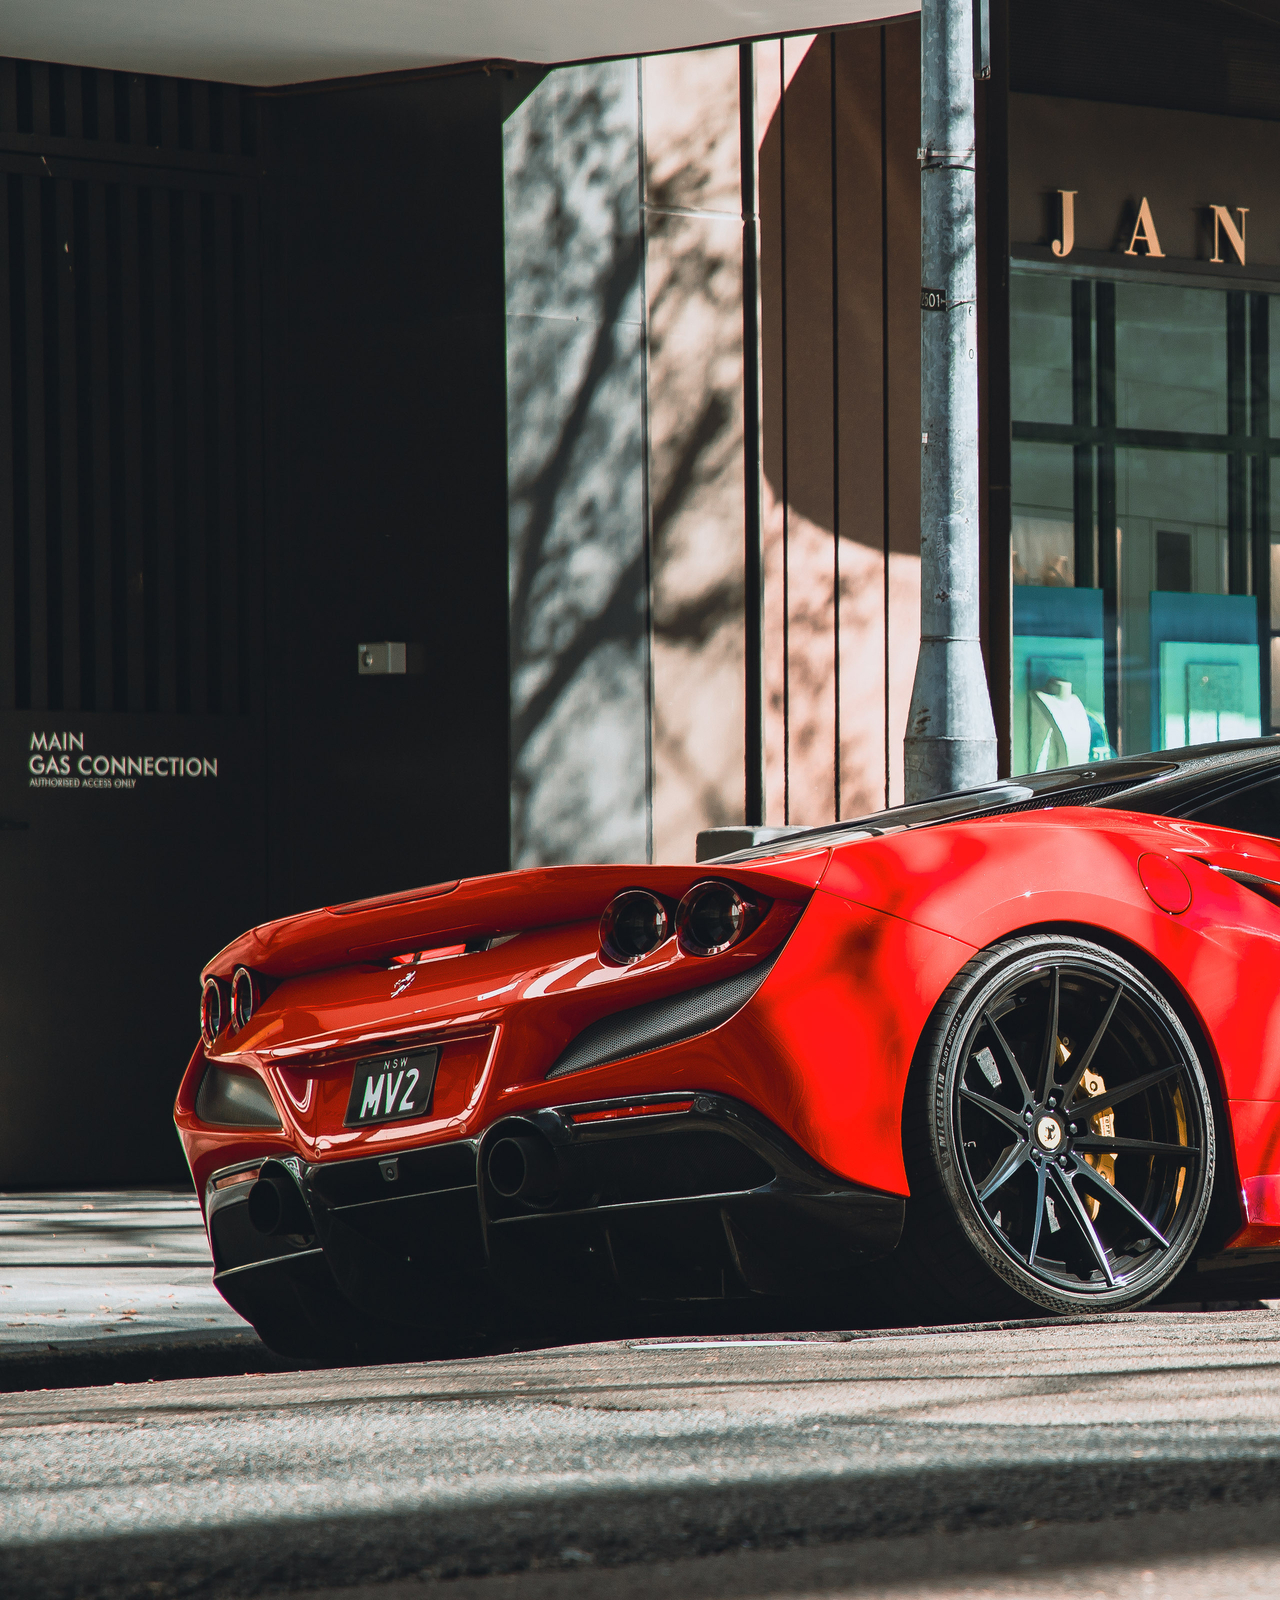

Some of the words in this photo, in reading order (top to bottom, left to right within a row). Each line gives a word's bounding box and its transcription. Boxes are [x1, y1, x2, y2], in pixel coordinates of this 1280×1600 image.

[1052, 190, 1249, 266] JAN
[30, 731, 84, 751] MAIN
[29, 754, 71, 775] GAS
[77, 755, 218, 777] CONNECTION
[29, 777, 80, 788] AUTHORISED
[82, 778, 112, 788] ACCESS
[114, 778, 137, 788] ONLY
[383, 1056, 409, 1070] NSW
[359, 1068, 420, 1119] MV2
[936, 1073, 946, 1148] MICHELIN
[941, 1046, 950, 1068] PILOT
[947, 1021, 959, 1046] SPORT
